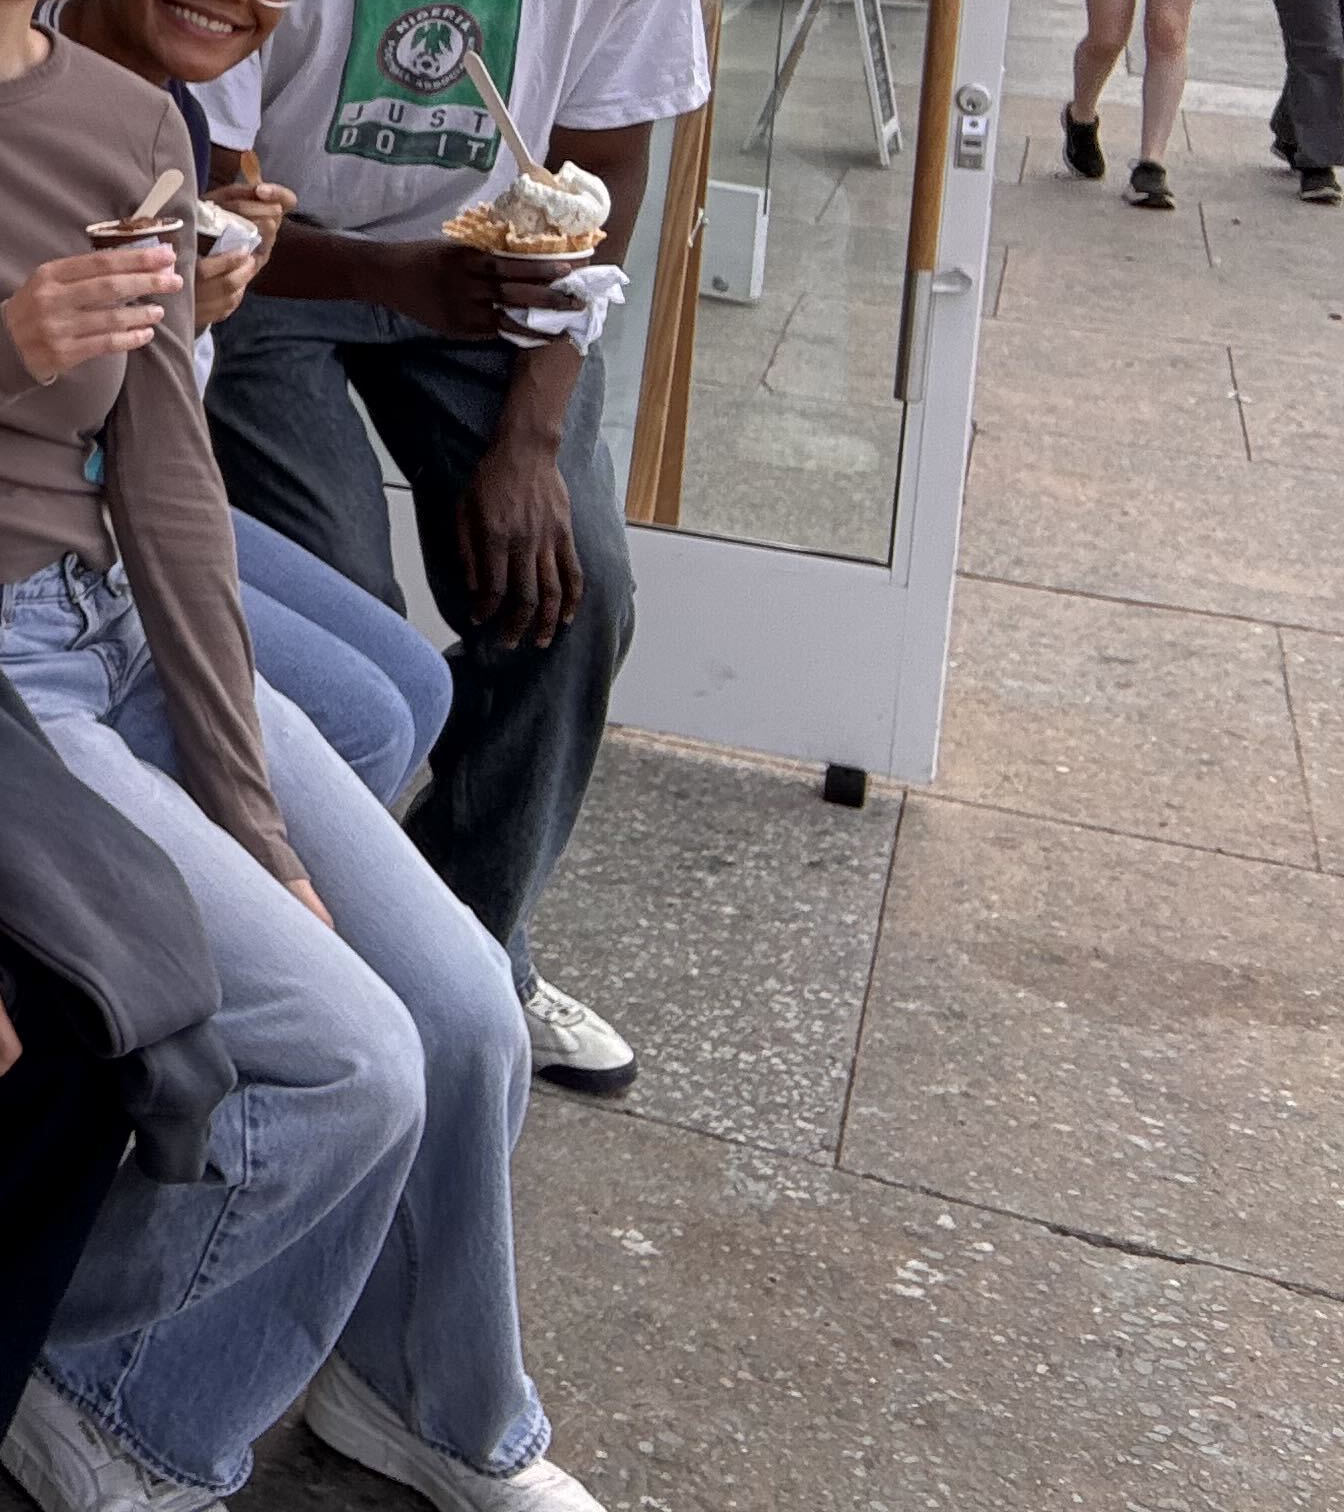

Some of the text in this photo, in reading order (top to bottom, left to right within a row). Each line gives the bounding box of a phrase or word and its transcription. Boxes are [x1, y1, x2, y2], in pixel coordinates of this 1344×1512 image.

[347, 102, 489, 134] JUST
[339, 126, 486, 162] DO IT
